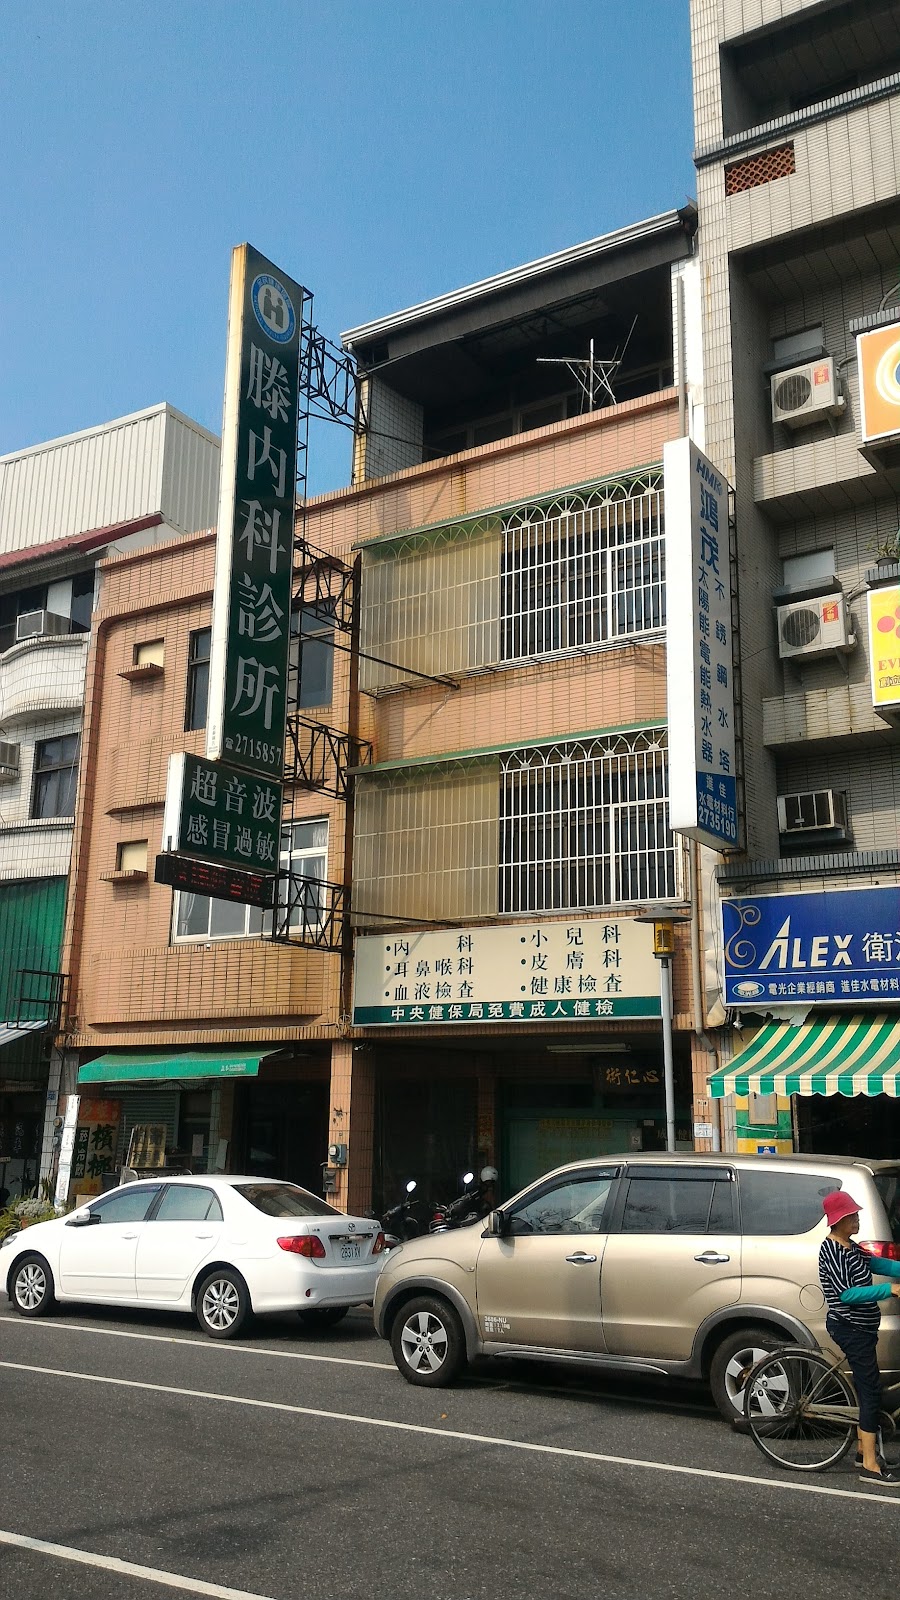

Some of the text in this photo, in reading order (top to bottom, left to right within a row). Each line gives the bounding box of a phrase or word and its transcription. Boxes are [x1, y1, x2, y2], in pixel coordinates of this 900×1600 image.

[700, 482, 720, 575] 鴻茂
[715, 578, 731, 774] 不銹鋼水塔
[235, 733, 282, 766] 2715857
[190, 765, 277, 823] 超音波
[699, 791, 735, 822] 水電材料行
[698, 805, 736, 839] 2735190
[187, 814, 275, 862] 感冒過敏
[530, 924, 622, 948] 小兒科
[758, 915, 854, 970] ALEX
[394, 956, 475, 978] 耳鼻喉科
[530, 949, 623, 971] 皮膚科
[394, 980, 474, 1001] 血液檢查
[530, 973, 623, 995] 健康檢查
[768, 981, 835, 996] 電光企業經銷商
[391, 999, 614, 1021] 中央健保局免費成人健檢
